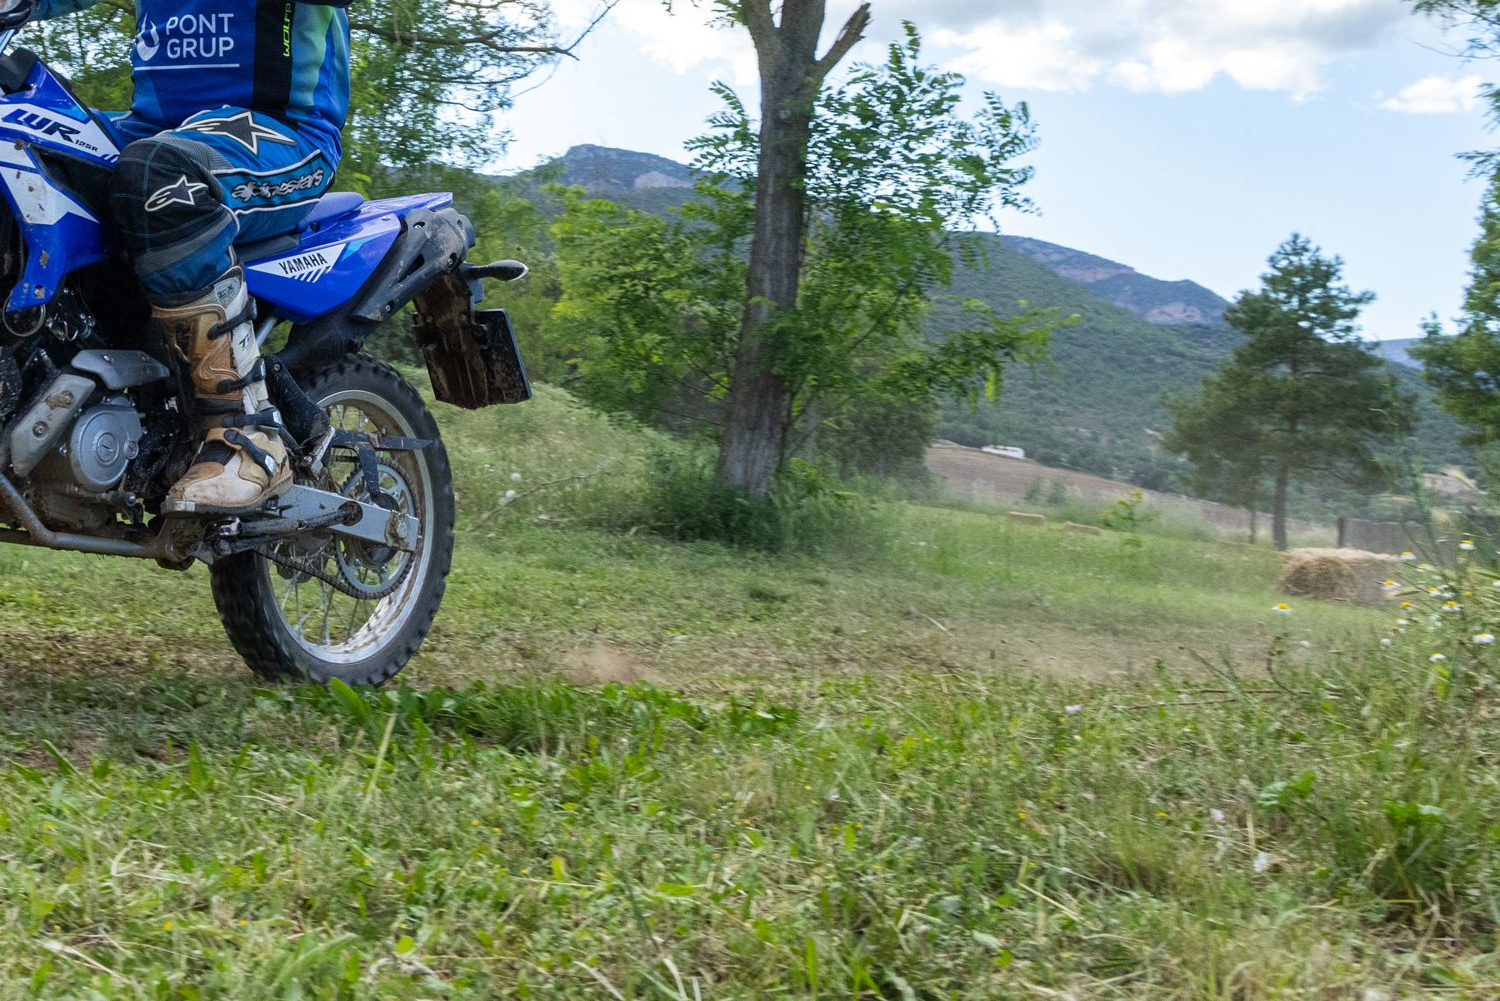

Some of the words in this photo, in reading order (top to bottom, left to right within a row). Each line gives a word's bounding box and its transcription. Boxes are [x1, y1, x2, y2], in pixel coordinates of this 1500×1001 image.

[165, 13, 235, 35] PONT
[166, 36, 235, 59] GRUP
[1, 108, 81, 143] WR
[278, 252, 328, 275] YAMAHA
